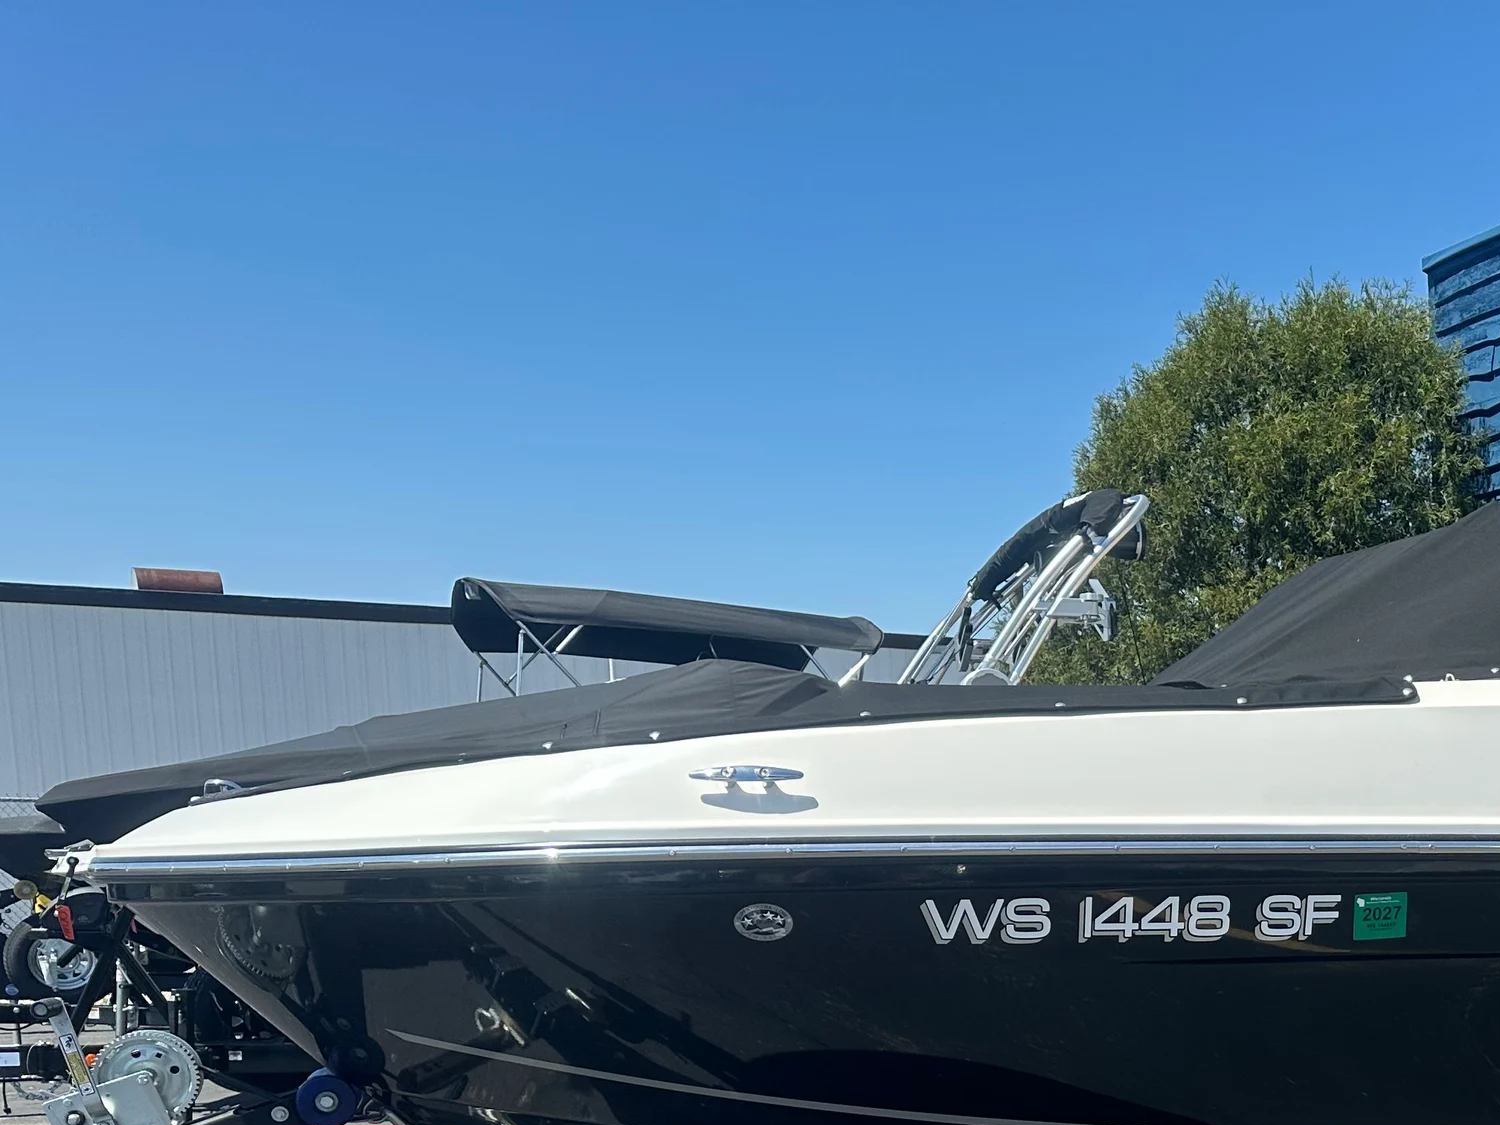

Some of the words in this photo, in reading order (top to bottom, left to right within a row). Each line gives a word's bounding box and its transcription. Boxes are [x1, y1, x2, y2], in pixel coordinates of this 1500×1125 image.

[920, 898, 1050, 945] WS
[1078, 894, 1231, 943] 1448
[1254, 894, 1341, 941] SF
[1362, 905, 1402, 921] 2027
